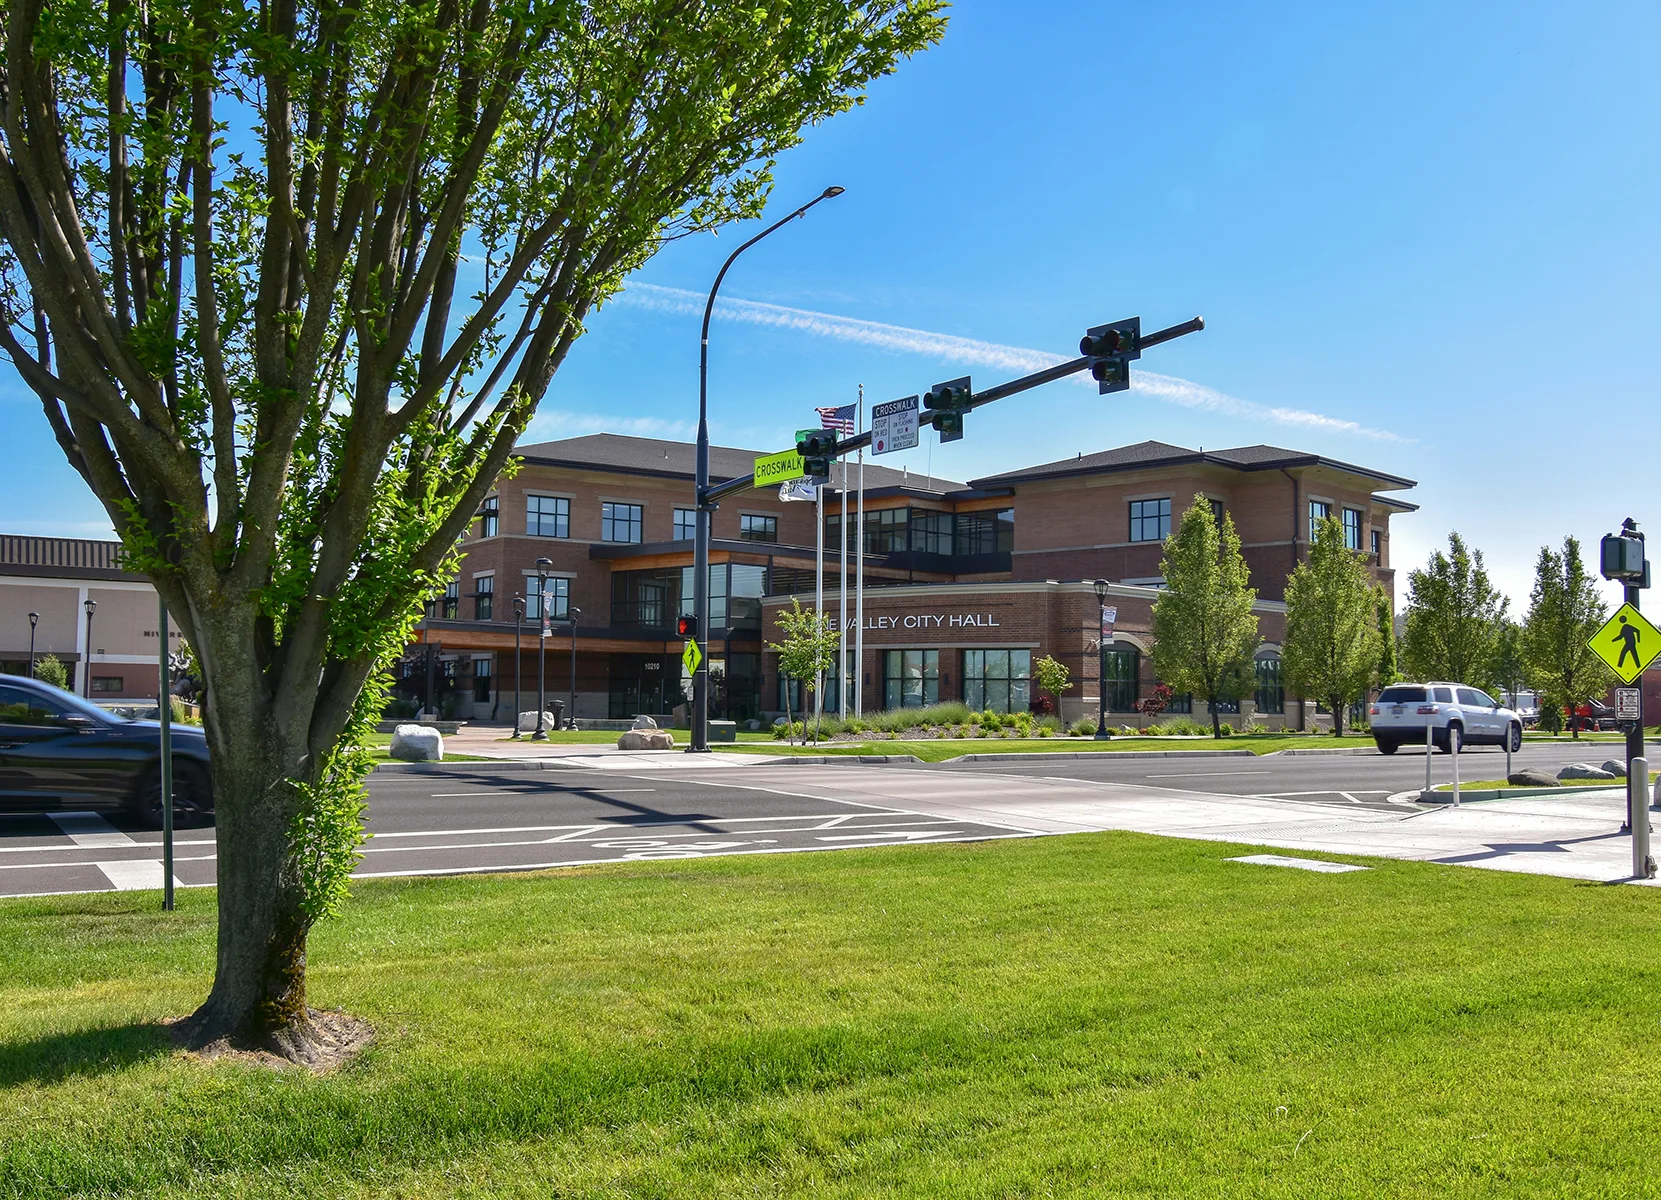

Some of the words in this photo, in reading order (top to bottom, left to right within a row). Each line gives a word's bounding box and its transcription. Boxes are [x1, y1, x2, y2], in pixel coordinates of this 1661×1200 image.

[875, 398, 915, 416] CROSSWALK
[874, 419, 887, 429] STOP
[756, 457, 803, 478] CROSSWALK
[904, 614, 945, 629] CITY
[949, 614, 1000, 627] HALL
